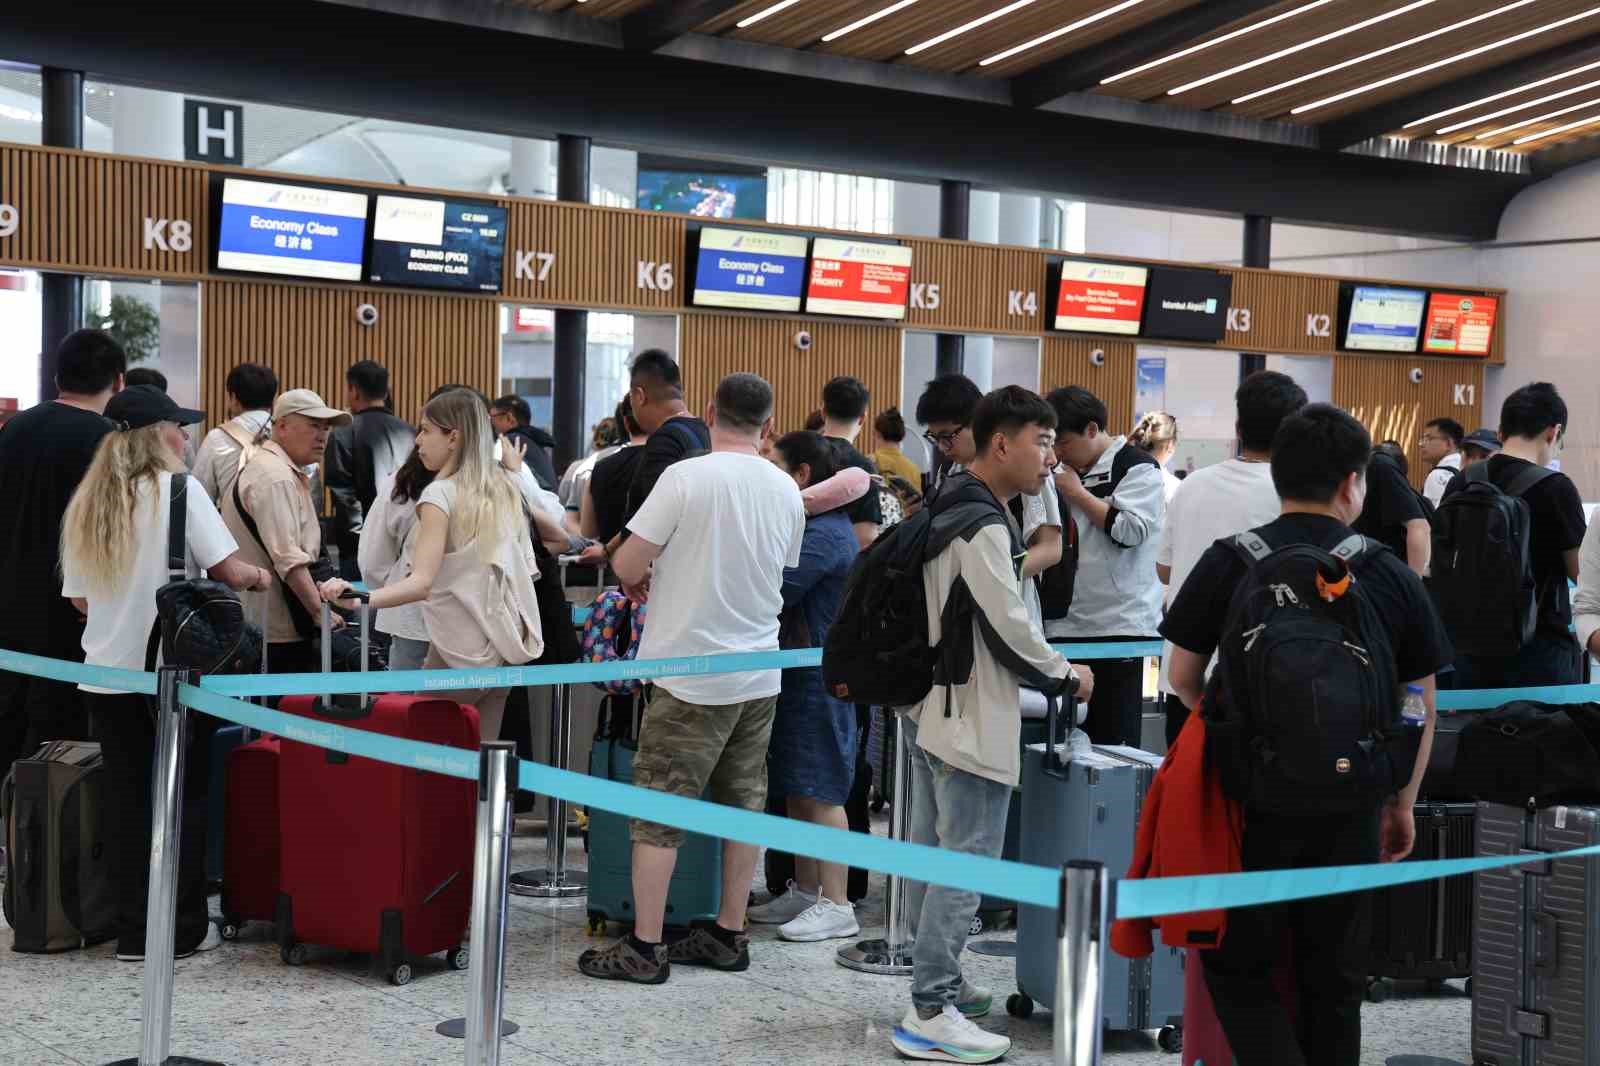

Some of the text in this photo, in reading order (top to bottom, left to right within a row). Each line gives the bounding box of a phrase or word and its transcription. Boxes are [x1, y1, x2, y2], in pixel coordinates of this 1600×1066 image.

[198, 106, 234, 158] H
[144, 217, 192, 252] K8
[250, 215, 339, 236] Economy Class
[515, 250, 555, 281] K7
[637, 259, 673, 291] K6
[718, 257, 785, 274] Economy Class
[910, 283, 940, 309] K5
[1008, 290, 1037, 316] K4
[1226, 307, 1250, 332] K3
[1306, 314, 1331, 337] K2
[1454, 384, 1475, 405] K1
[424, 677, 465, 688] Istanbul
